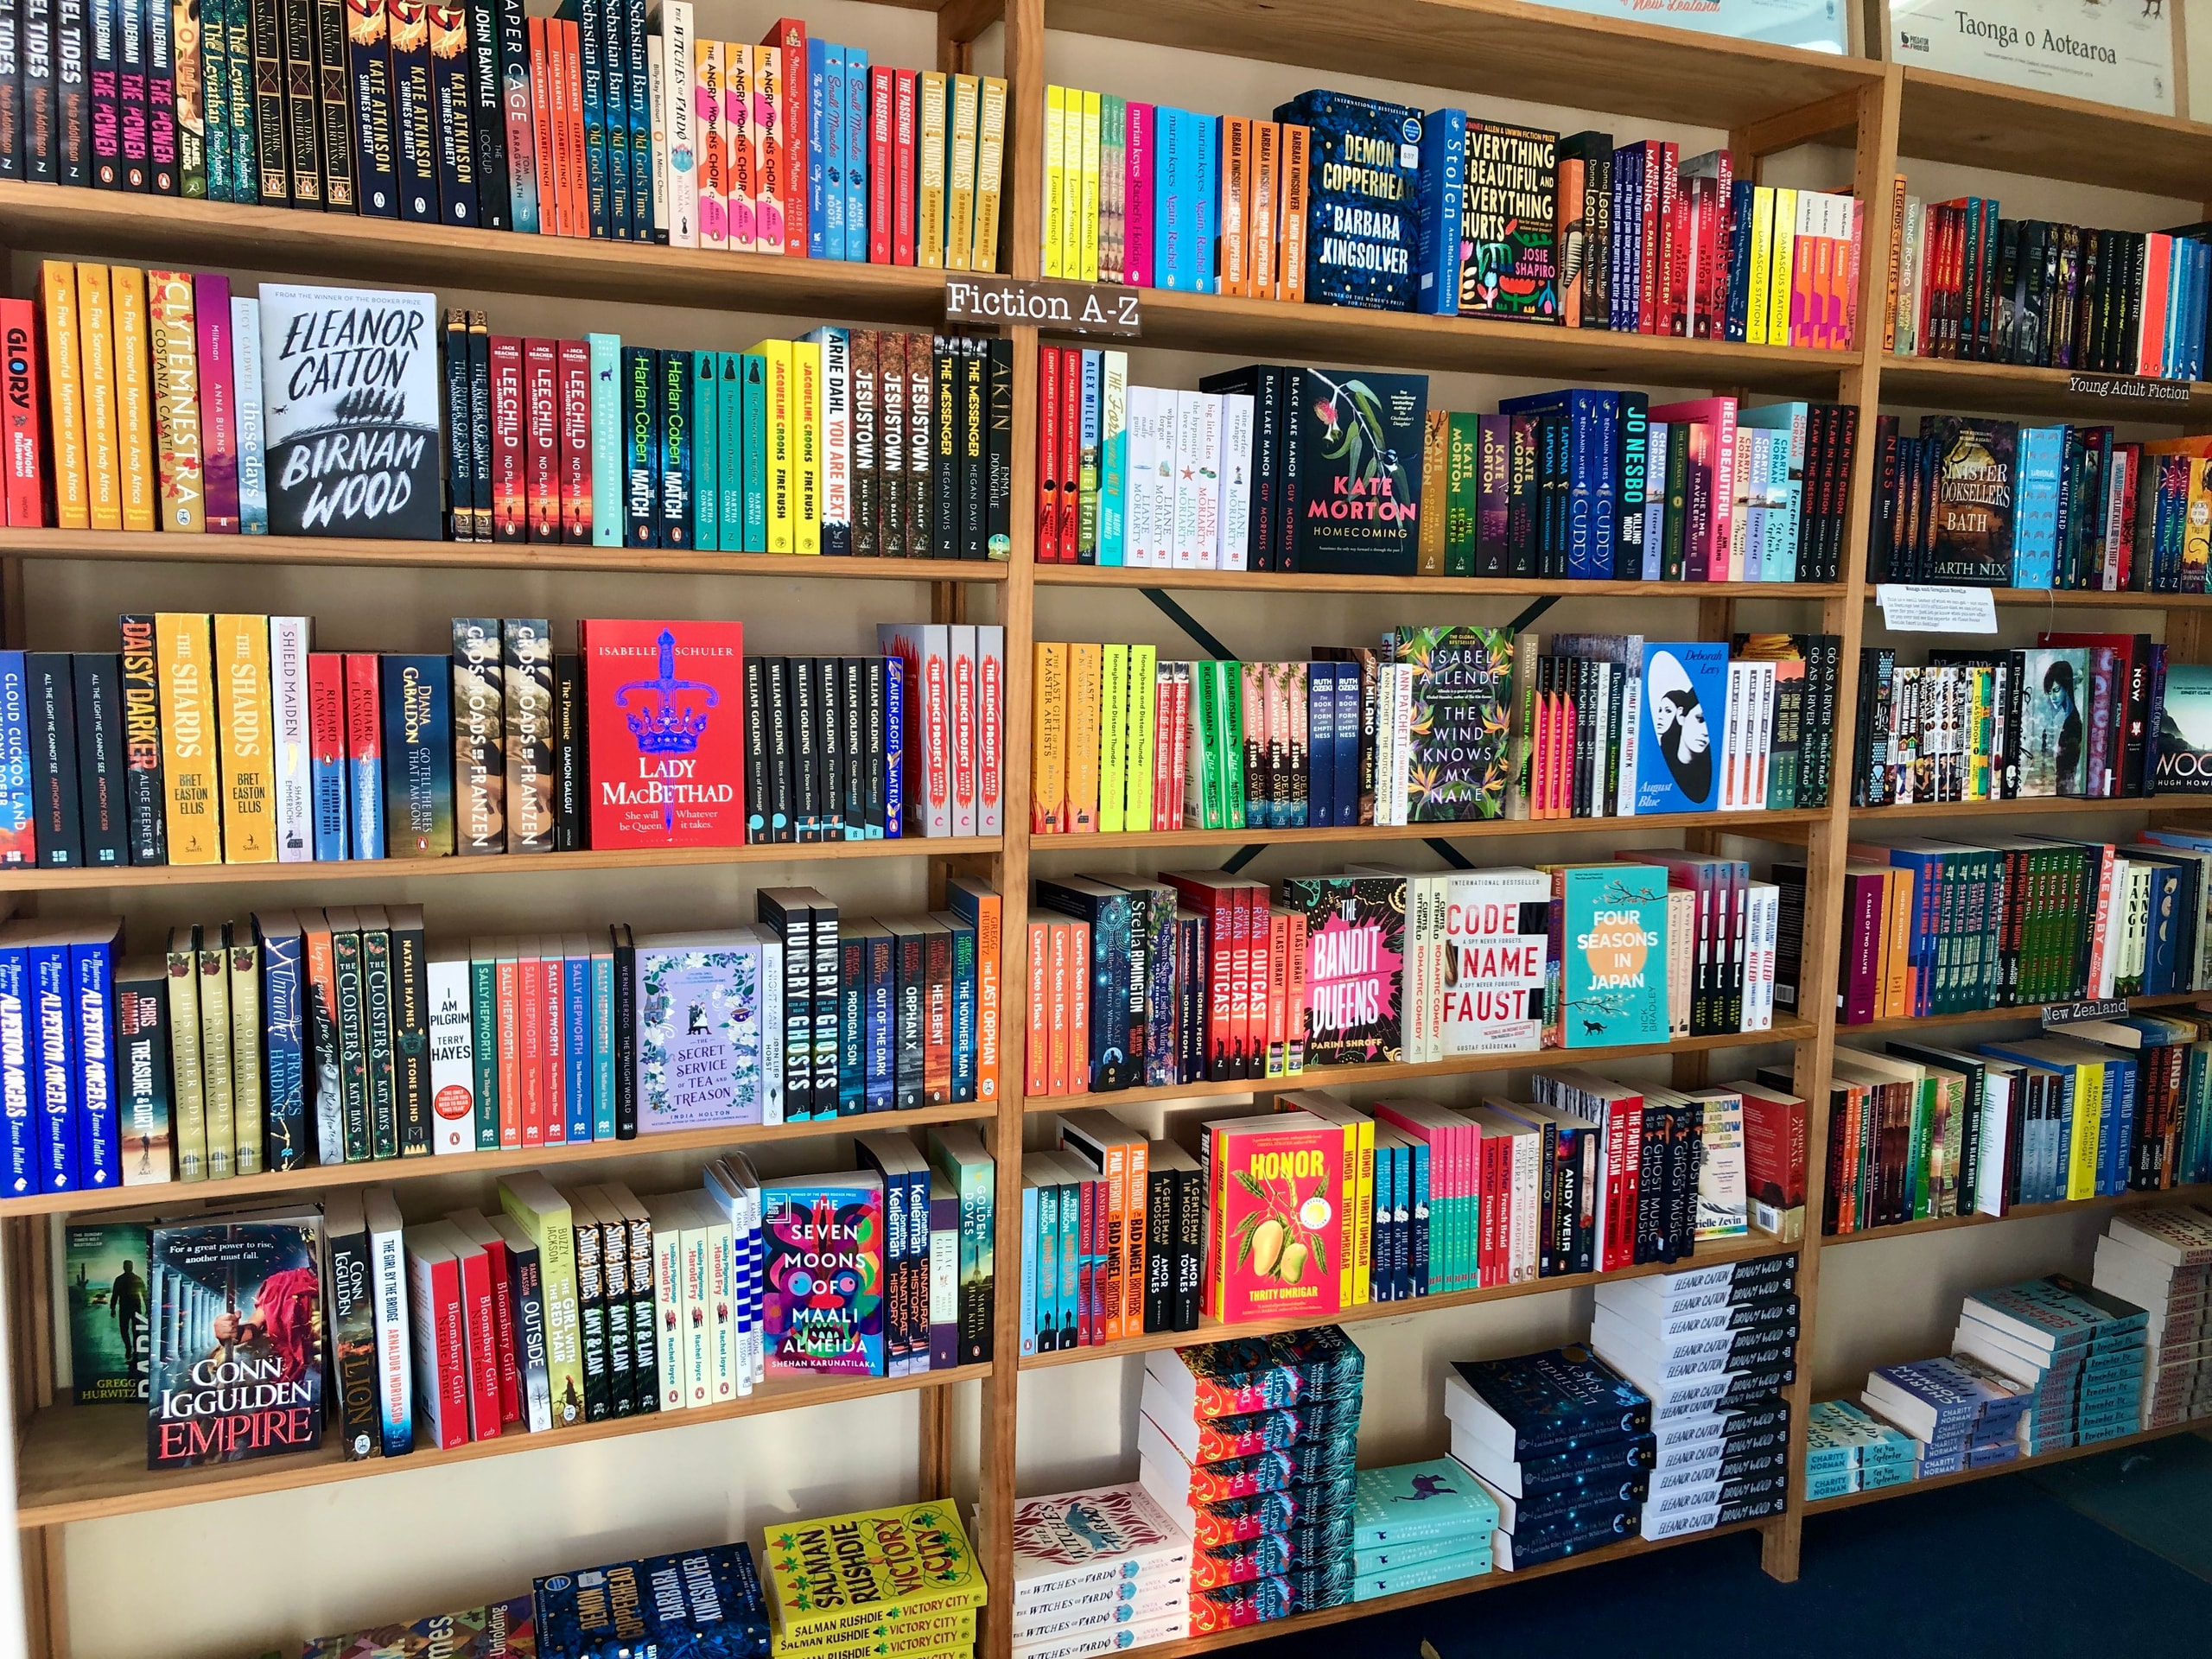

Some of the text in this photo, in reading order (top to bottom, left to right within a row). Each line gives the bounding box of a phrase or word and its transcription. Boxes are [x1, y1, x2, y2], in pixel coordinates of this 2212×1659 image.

[1955, 10, 2018, 44] Taonga
[2025, 31, 2036, 44] o
[2043, 29, 2117, 65] Aotearoa
[1334, 97, 1408, 116] INTERNATIONAL BESTSELLER
[450, 73, 472, 183] KATE ATKINSON
[764, 52, 778, 194] THE ANGRY WOMEN'S CHOIR
[1344, 133, 1395, 167] DEMON
[1463, 131, 1554, 168] EVERYTHING
[1446, 138, 1462, 220] Stolen
[1471, 161, 1554, 193] BEAUTIFUL AND
[1463, 185, 1554, 219] EVERYTHING
[1462, 215, 1505, 241] HURTS
[1323, 207, 1408, 275] BARBARA KINGSOLVER
[1904, 204, 1916, 286] WAKING ROMEO
[1522, 247, 1548, 262] JOSIE
[1515, 261, 1555, 277] SHAPIRO
[370, 296, 400, 305] BOOKER
[946, 283, 1140, 327] Fiction A-Z
[211, 325, 219, 361] Milkman
[279, 308, 424, 361] ELEANOR
[8, 327, 30, 410] GLORY
[288, 349, 410, 401] CATTON
[164, 282, 200, 505] CLYTEMNESTRA
[2069, 377, 2190, 401] Young Adult Fiction
[214, 383, 226, 453] ANNA BURNS
[634, 356, 649, 463] Harlan Coben
[1207, 404, 1216, 417] big
[1628, 407, 1645, 430] JO
[912, 372, 929, 473] JESUSTOWN
[14, 432, 23, 478] Bulawayo
[281, 432, 426, 489] BIRNAM
[1262, 440, 1272, 478] MANOR
[1718, 401, 1735, 520] HELLO BEAUTIFUL
[830, 419, 845, 519] YOU ARE NEXT
[631, 470, 648, 517] MATCH
[1334, 475, 1392, 497] KATE
[1942, 481, 2011, 508] OOKSELLERS
[301, 470, 413, 530] WOOD
[1308, 500, 1416, 521] MORTON
[1313, 527, 1408, 539] HOMECOMING
[1633, 512, 1642, 544] KILLING
[1948, 512, 1987, 532] BATH
[1592, 499, 1612, 570] CUDDY
[1979, 563, 2006, 575] NIX
[175, 632, 192, 658] THE
[598, 645, 734, 657] ISABELLE SCHULER
[1429, 649, 1492, 665] ISABEL
[1685, 649, 1722, 664] Deborah
[283, 630, 297, 737] SHIELD MAIDEN
[1419, 670, 1500, 686] ALLENDE
[123, 621, 158, 770] DAISY DARKER
[172, 663, 201, 758] SHARDS
[1397, 670, 1408, 748] ANN PATCHETT
[1443, 705, 1478, 721] THE
[518, 626, 539, 846] CROSSROADS FRANZEN
[1433, 726, 1485, 742] WIND
[1422, 747, 1492, 763] KNOWS
[179, 773, 202, 788] BRET
[638, 757, 697, 780] LADY
[1445, 767, 1471, 782] MY
[175, 787, 208, 802] EASTON
[1430, 786, 1484, 804] NAME
[1638, 781, 1673, 796] August
[180, 801, 205, 815] ELLIS
[676, 810, 718, 819] Whatever
[1638, 796, 1662, 809] Blue
[620, 820, 664, 831] be Queen.
[625, 810, 659, 821] She will
[681, 819, 714, 829] it takes.
[2096, 849, 2113, 945] FAKE BABY
[1341, 898, 1357, 923] THE
[1446, 902, 1517, 936] CODE
[1593, 910, 1641, 926] FOUR
[1313, 925, 1382, 980] BANDIT
[1576, 931, 1659, 950] SEASONS
[786, 920, 810, 999] HUNGRY
[1462, 945, 1538, 978] NAME
[1613, 953, 1631, 968] IN
[1586, 973, 1644, 991] JAPAN
[442, 1001, 457, 1012] AM
[1312, 978, 1380, 1039] QUEENS
[1443, 988, 1528, 1023] FAUST
[1649, 986, 1657, 1032] BRADLEY
[2043, 998, 2127, 1022] New Zealand
[430, 1013, 470, 1027] PILGRIM
[437, 1035, 464, 1046] TERRY
[787, 1014, 810, 1090] GHOSTS
[1311, 1038, 1383, 1051] PARINI SHROFF
[431, 1046, 471, 1062] HAYES
[677, 1045, 725, 1061] SECRET
[676, 1059, 728, 1077] SERVICE
[407, 1058, 417, 1123] STONE BLIND
[688, 1074, 712, 1088] TEA
[673, 1088, 732, 1106] TREASON
[670, 1110, 731, 1121] INDIA HOLTON
[1249, 1150, 1325, 1179] HONOR
[810, 1198, 838, 1211] THE
[1560, 1168, 1575, 1253] ANDY WEIR
[789, 1224, 859, 1241] SEVEN
[169, 1245, 185, 1255] For
[194, 1245, 217, 1255] great
[219, 1243, 245, 1255] power
[246, 1242, 255, 1250] to
[185, 1253, 219, 1263] another
[221, 1252, 241, 1262] must
[784, 1254, 867, 1268] MOONS
[1674, 1259, 1783, 1293] ELEANOR CATTON BIRNAM WOOD
[1249, 1287, 1319, 1302] THRITY UMRIGAR
[791, 1309, 859, 1325] MAALI
[782, 1338, 868, 1355] ALMEIDA
[192, 1357, 283, 1387] CONN
[772, 1359, 877, 1369] SHEHAN KARUNATILAKA
[97, 1378, 137, 1389] GREGG
[1242, 1383, 1252, 1404] DAY
[1262, 1373, 1273, 1409] FALLEN
[1271, 1373, 1283, 1408] NIGHT
[1309, 1364, 1318, 1402] SAMANTHA
[1315, 1363, 1324, 1401] SHANNON
[82, 1389, 137, 1400] HURWITZ
[160, 1380, 312, 1419] IGGULDEN
[1941, 1414, 1971, 1425] NORMAN
[1943, 1406, 1972, 1417] CHARITY
[157, 1408, 315, 1459] EMPIRE
[2084, 1427, 2115, 1441] Remember
[1814, 1484, 1847, 1496] NORMAN
[1815, 1476, 1847, 1488] CHARITY
[831, 1522, 880, 1605] RUSHDIE
[877, 1518, 924, 1596] VICTORY
[915, 1529, 952, 1574] CITY
[796, 1529, 845, 1609] SALMAN
[1033, 1577, 1077, 1595] WITCHES
[795, 1594, 969, 1638] SALMAN RUSHDIE VICTORY CITY
